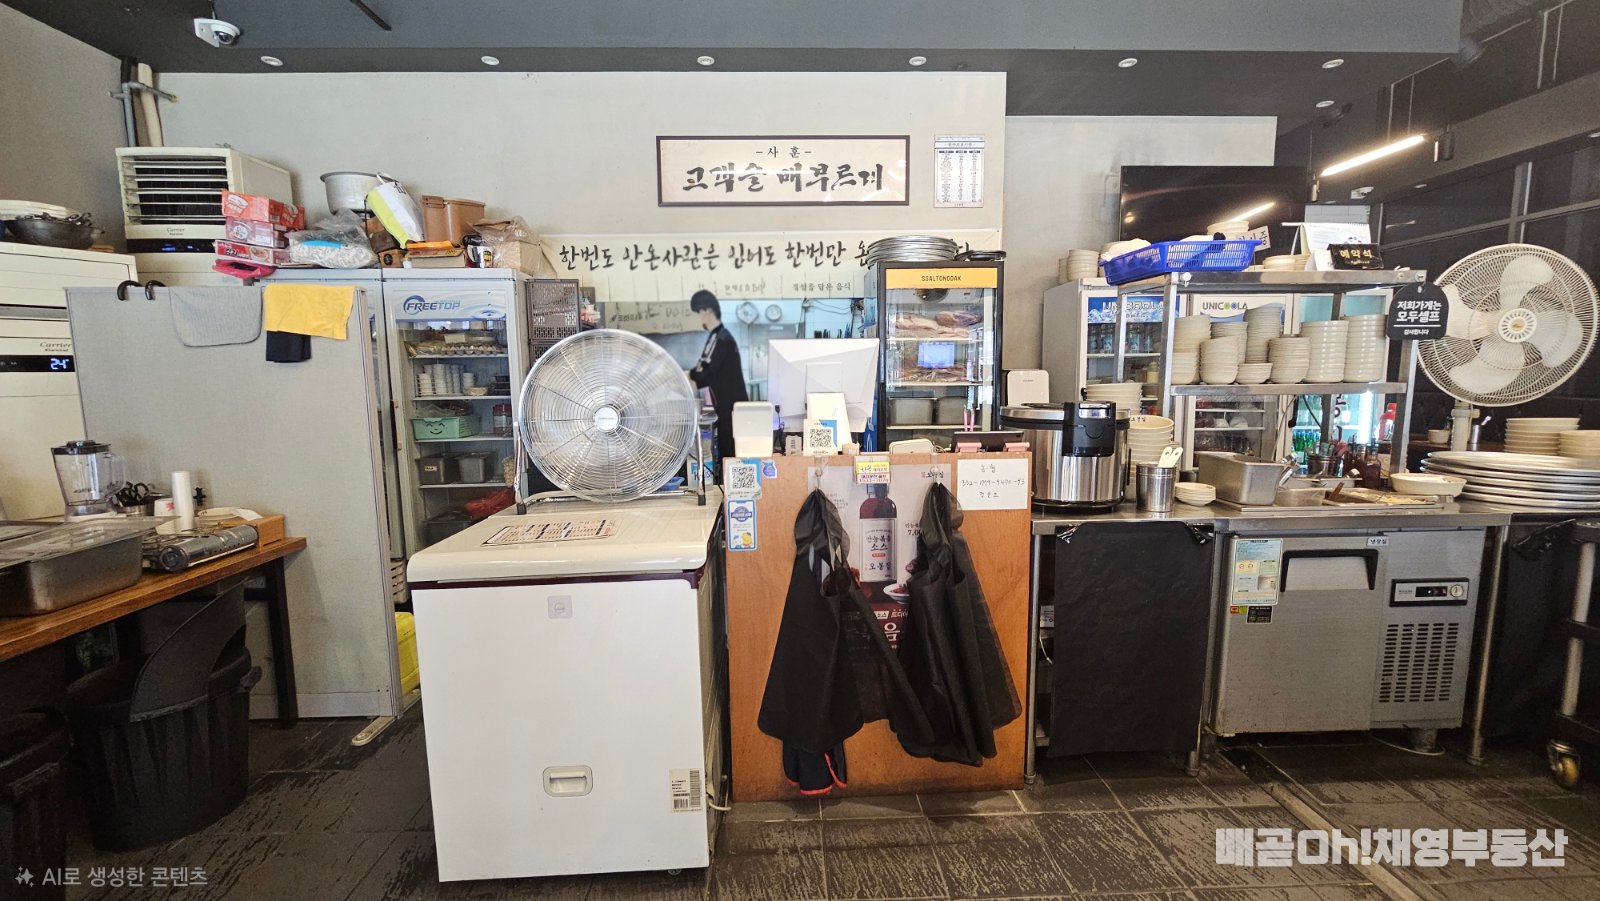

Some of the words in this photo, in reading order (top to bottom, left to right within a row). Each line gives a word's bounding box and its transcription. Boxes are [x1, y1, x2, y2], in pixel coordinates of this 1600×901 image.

[559, 244, 615, 271] 한번도
[785, 240, 847, 268] 한번만
[1339, 249, 1373, 259] 예약석
[407, 302, 460, 312] FREETOP
[1397, 300, 1443, 311] 저희가게는
